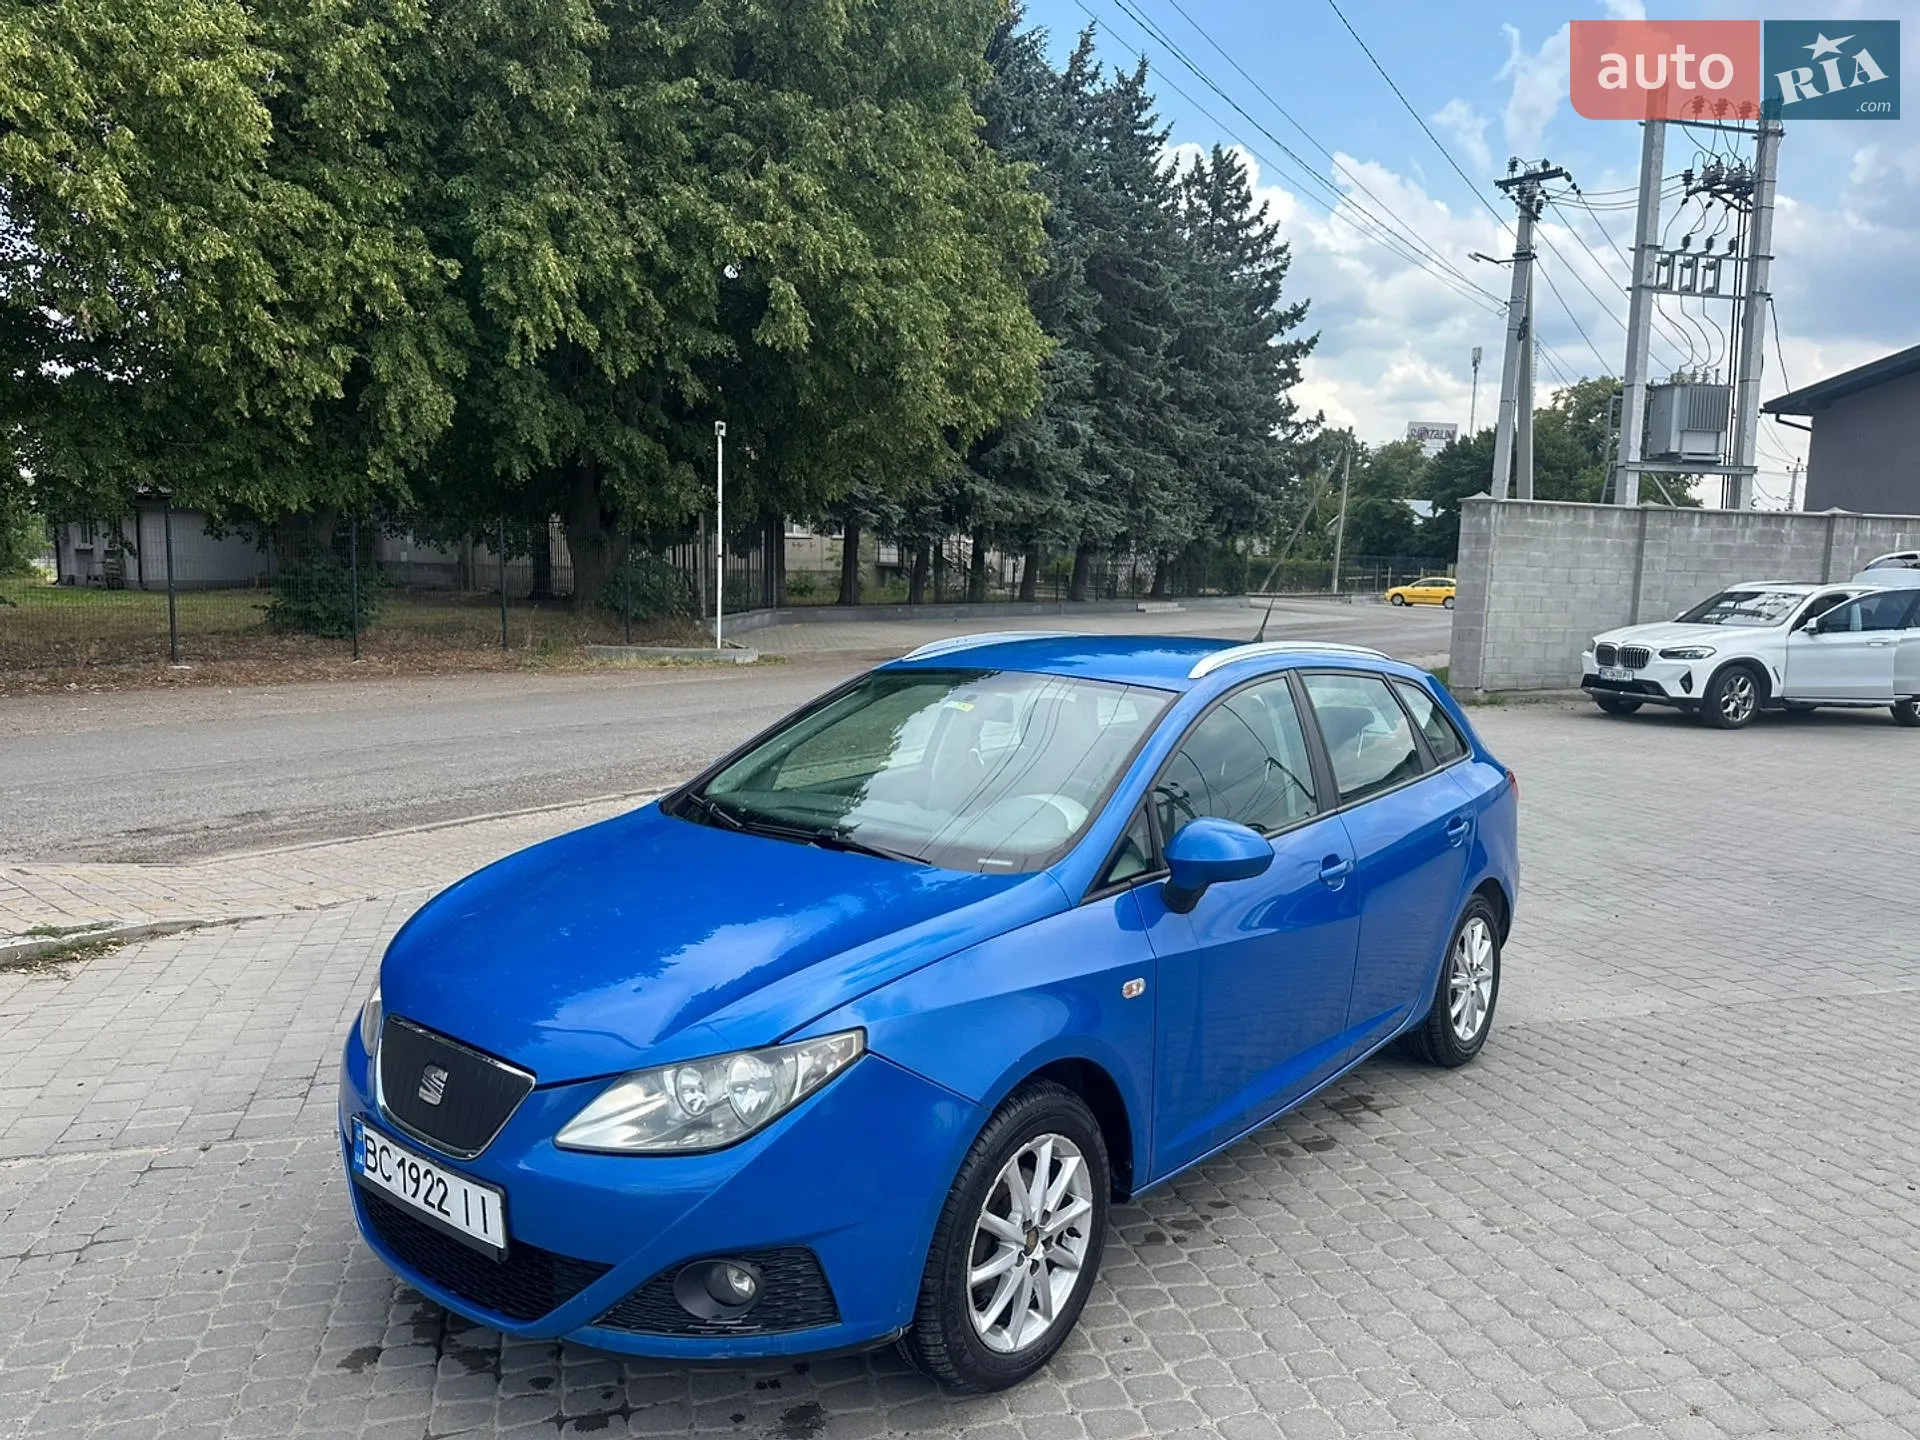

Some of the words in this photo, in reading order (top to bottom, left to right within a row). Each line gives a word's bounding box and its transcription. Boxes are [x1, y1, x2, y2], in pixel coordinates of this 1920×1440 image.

[364, 1134, 392, 1183] BC
[396, 1157, 451, 1218] 1922
[463, 1188, 488, 1235] II
